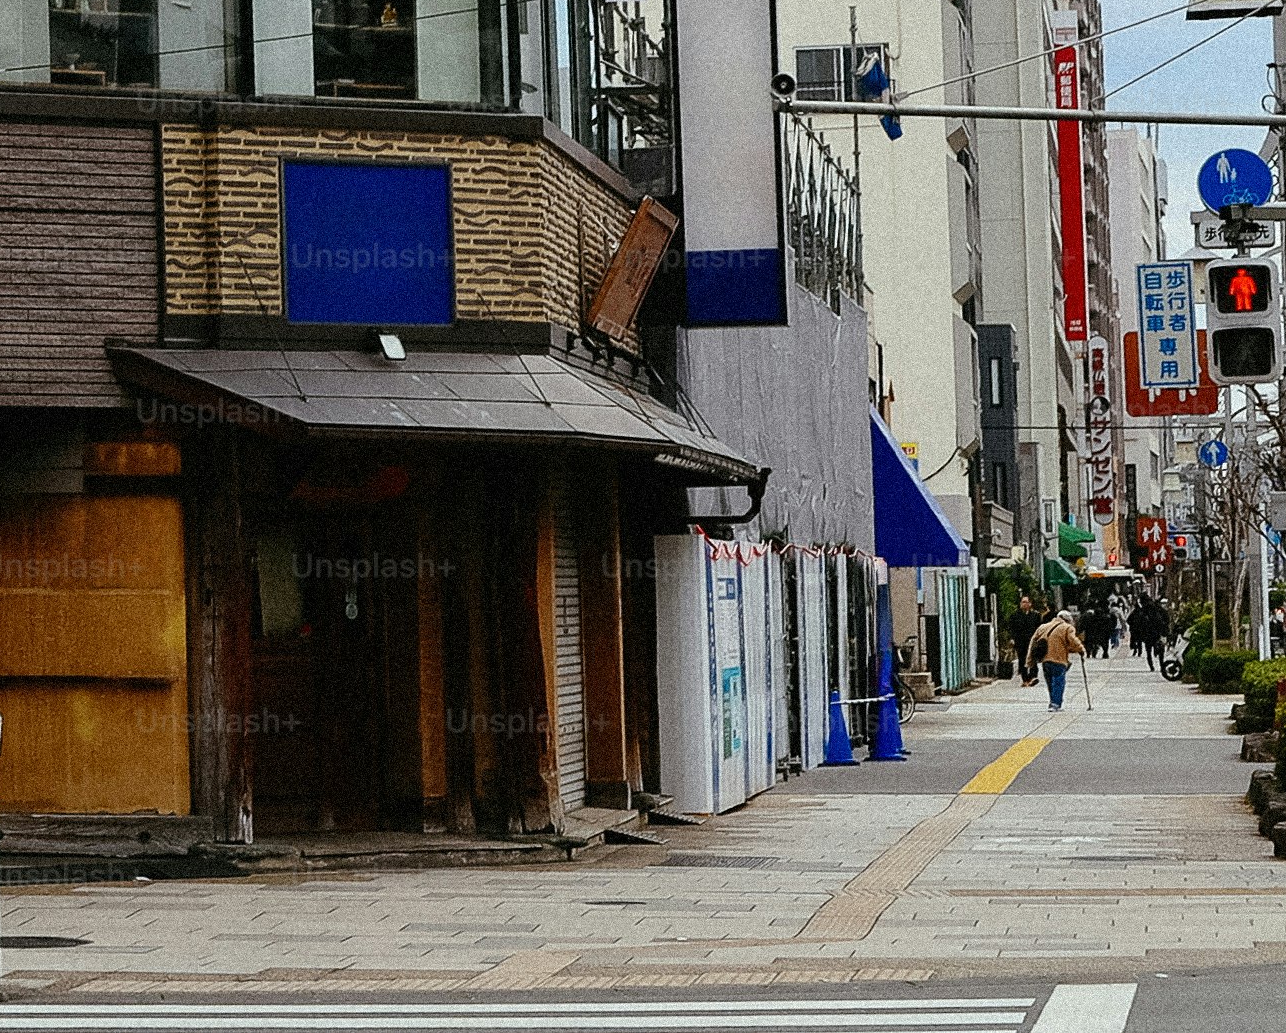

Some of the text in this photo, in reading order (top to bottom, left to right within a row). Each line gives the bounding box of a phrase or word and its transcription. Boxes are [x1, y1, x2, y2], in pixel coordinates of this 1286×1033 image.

[1143, 271, 1165, 332] 自転車
[1166, 271, 1189, 332] 歩行者
[1158, 337, 1179, 379] 専用
